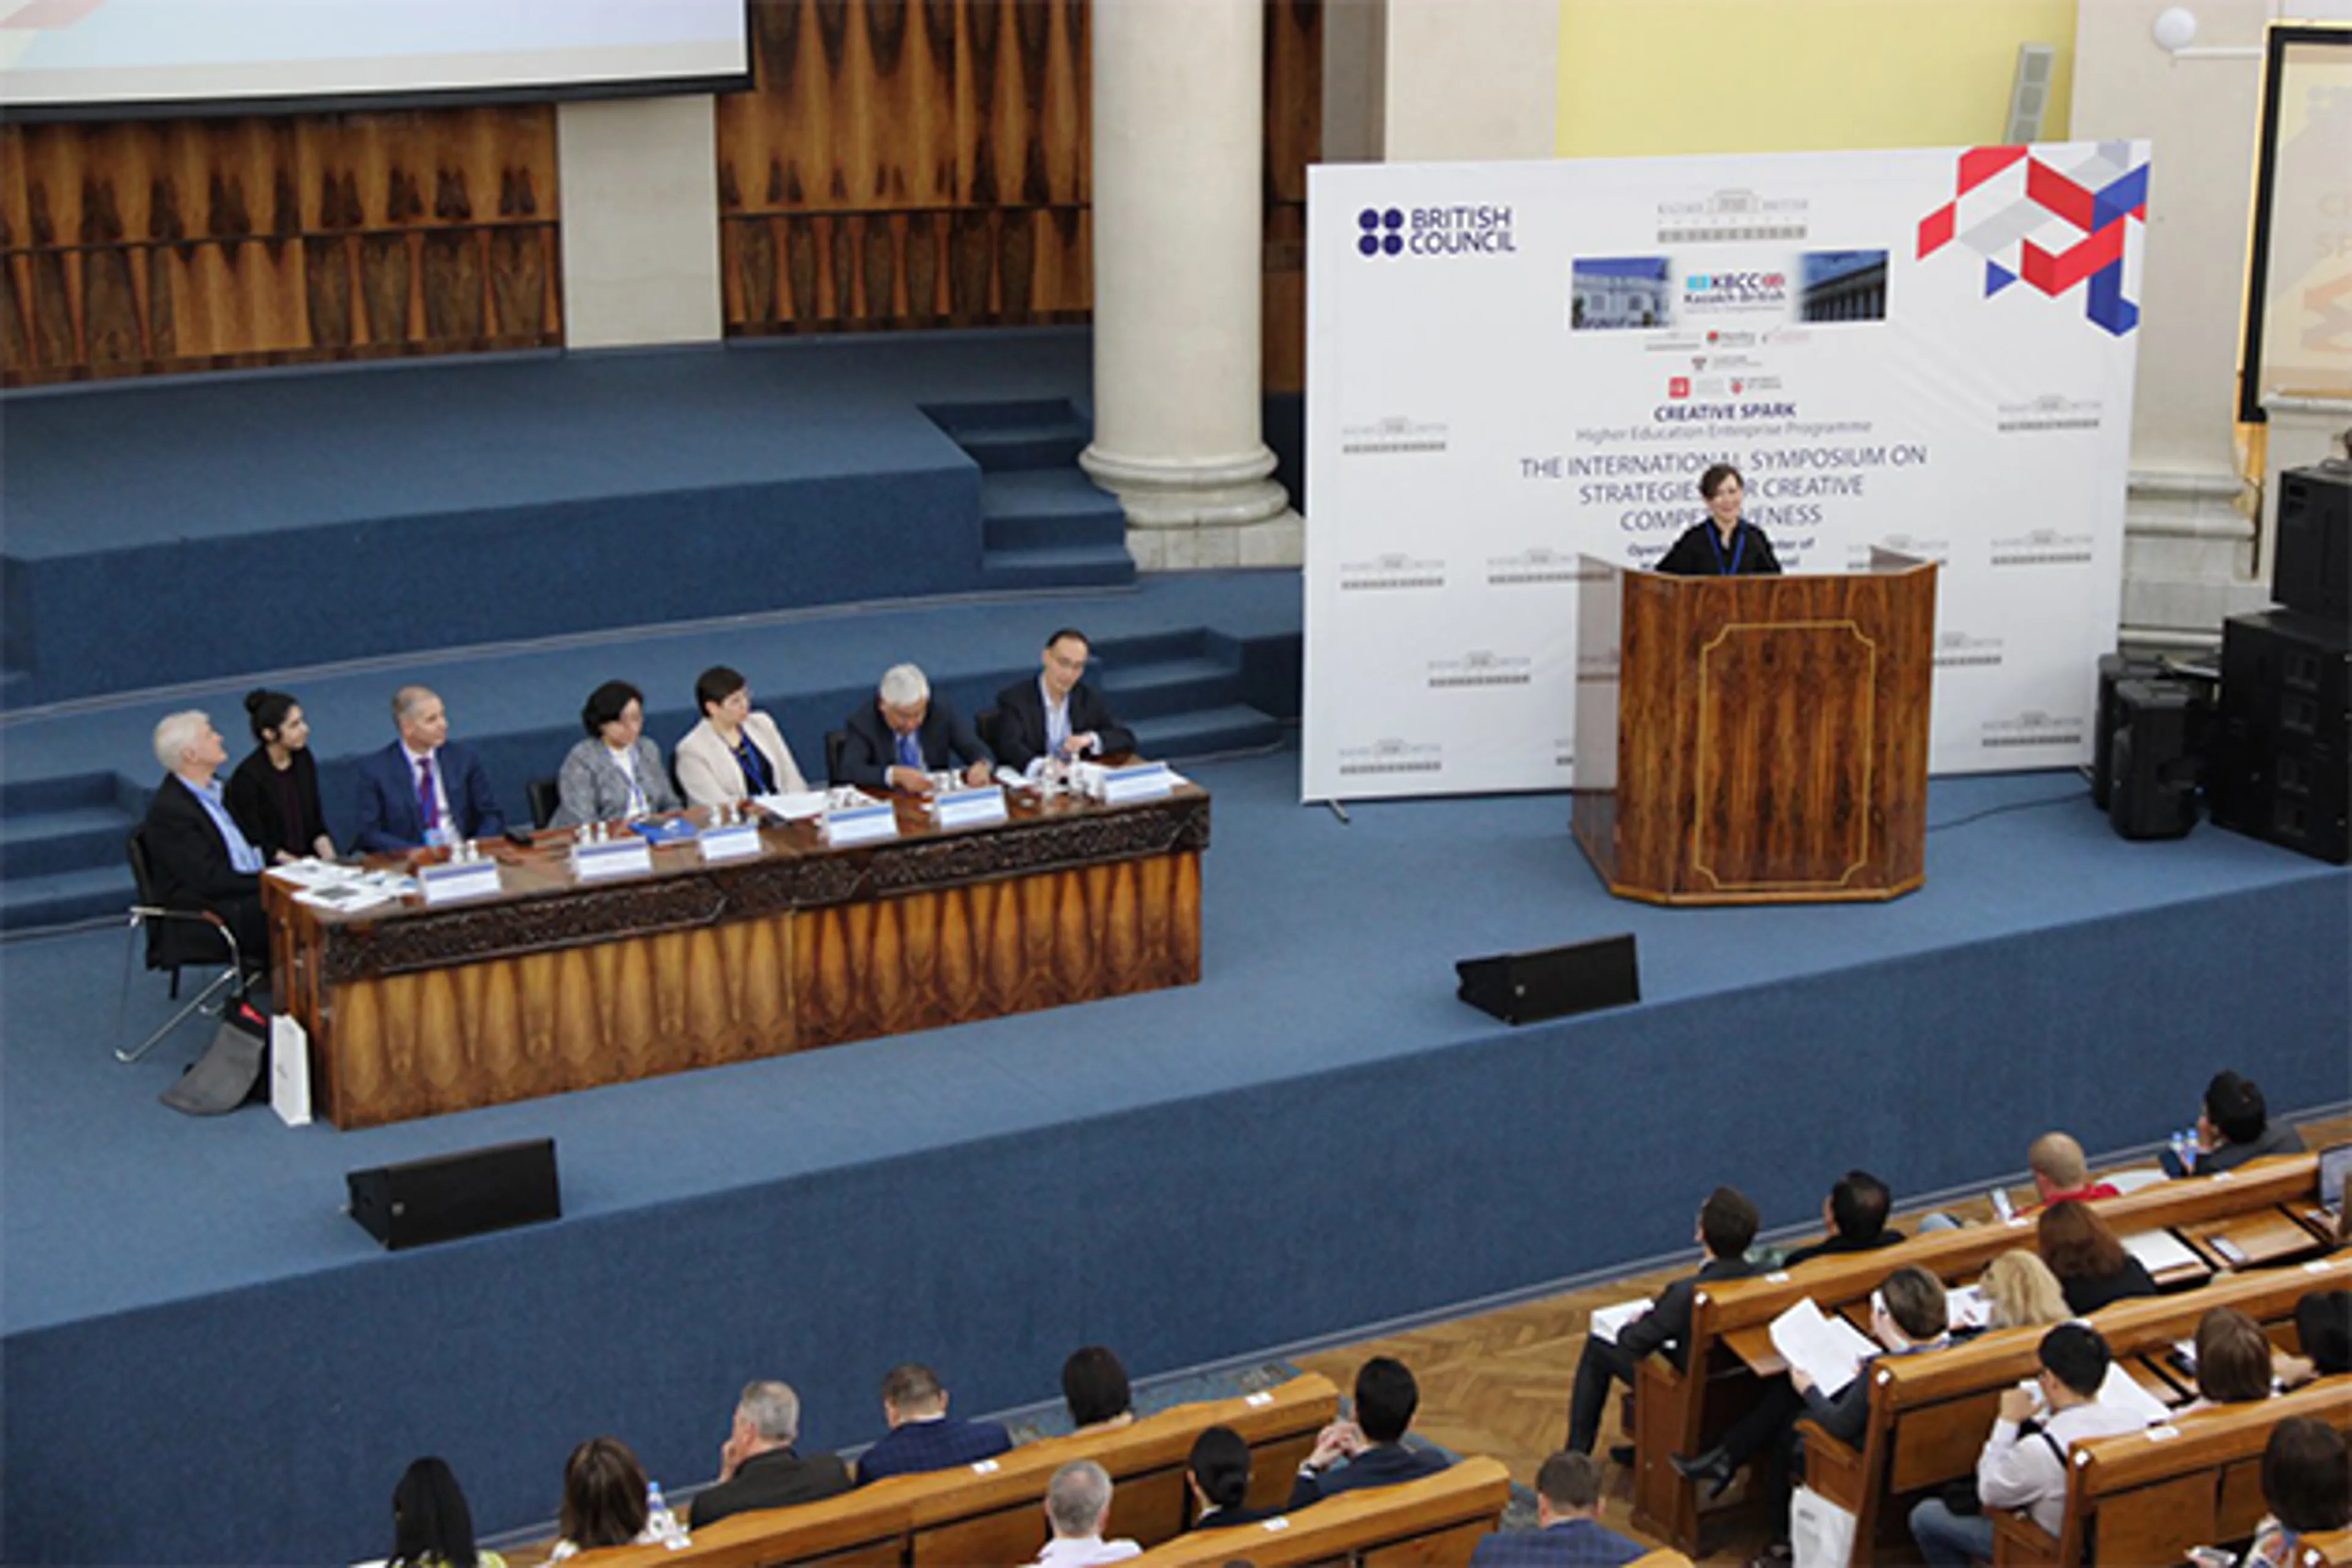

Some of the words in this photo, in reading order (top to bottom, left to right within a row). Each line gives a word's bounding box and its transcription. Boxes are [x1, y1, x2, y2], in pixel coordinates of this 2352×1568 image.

[1411, 206, 1511, 229] BRITISH
[1410, 230, 1516, 254] COUNCIL
[1654, 405, 1734, 423] CREATIVE
[1741, 402, 1796, 419] SPARK
[1576, 427, 1624, 445] Higher
[1630, 424, 1703, 440] Education
[1709, 423, 1782, 438] Enterprise
[1787, 421, 1872, 437] Programme
[1521, 457, 1561, 478] THE
[1750, 446, 1886, 471] SYMPOSIUM
[1891, 443, 1927, 467] ON
[1578, 480, 1695, 505] STRATEGIE
[1763, 475, 1863, 498] CREATIVE
